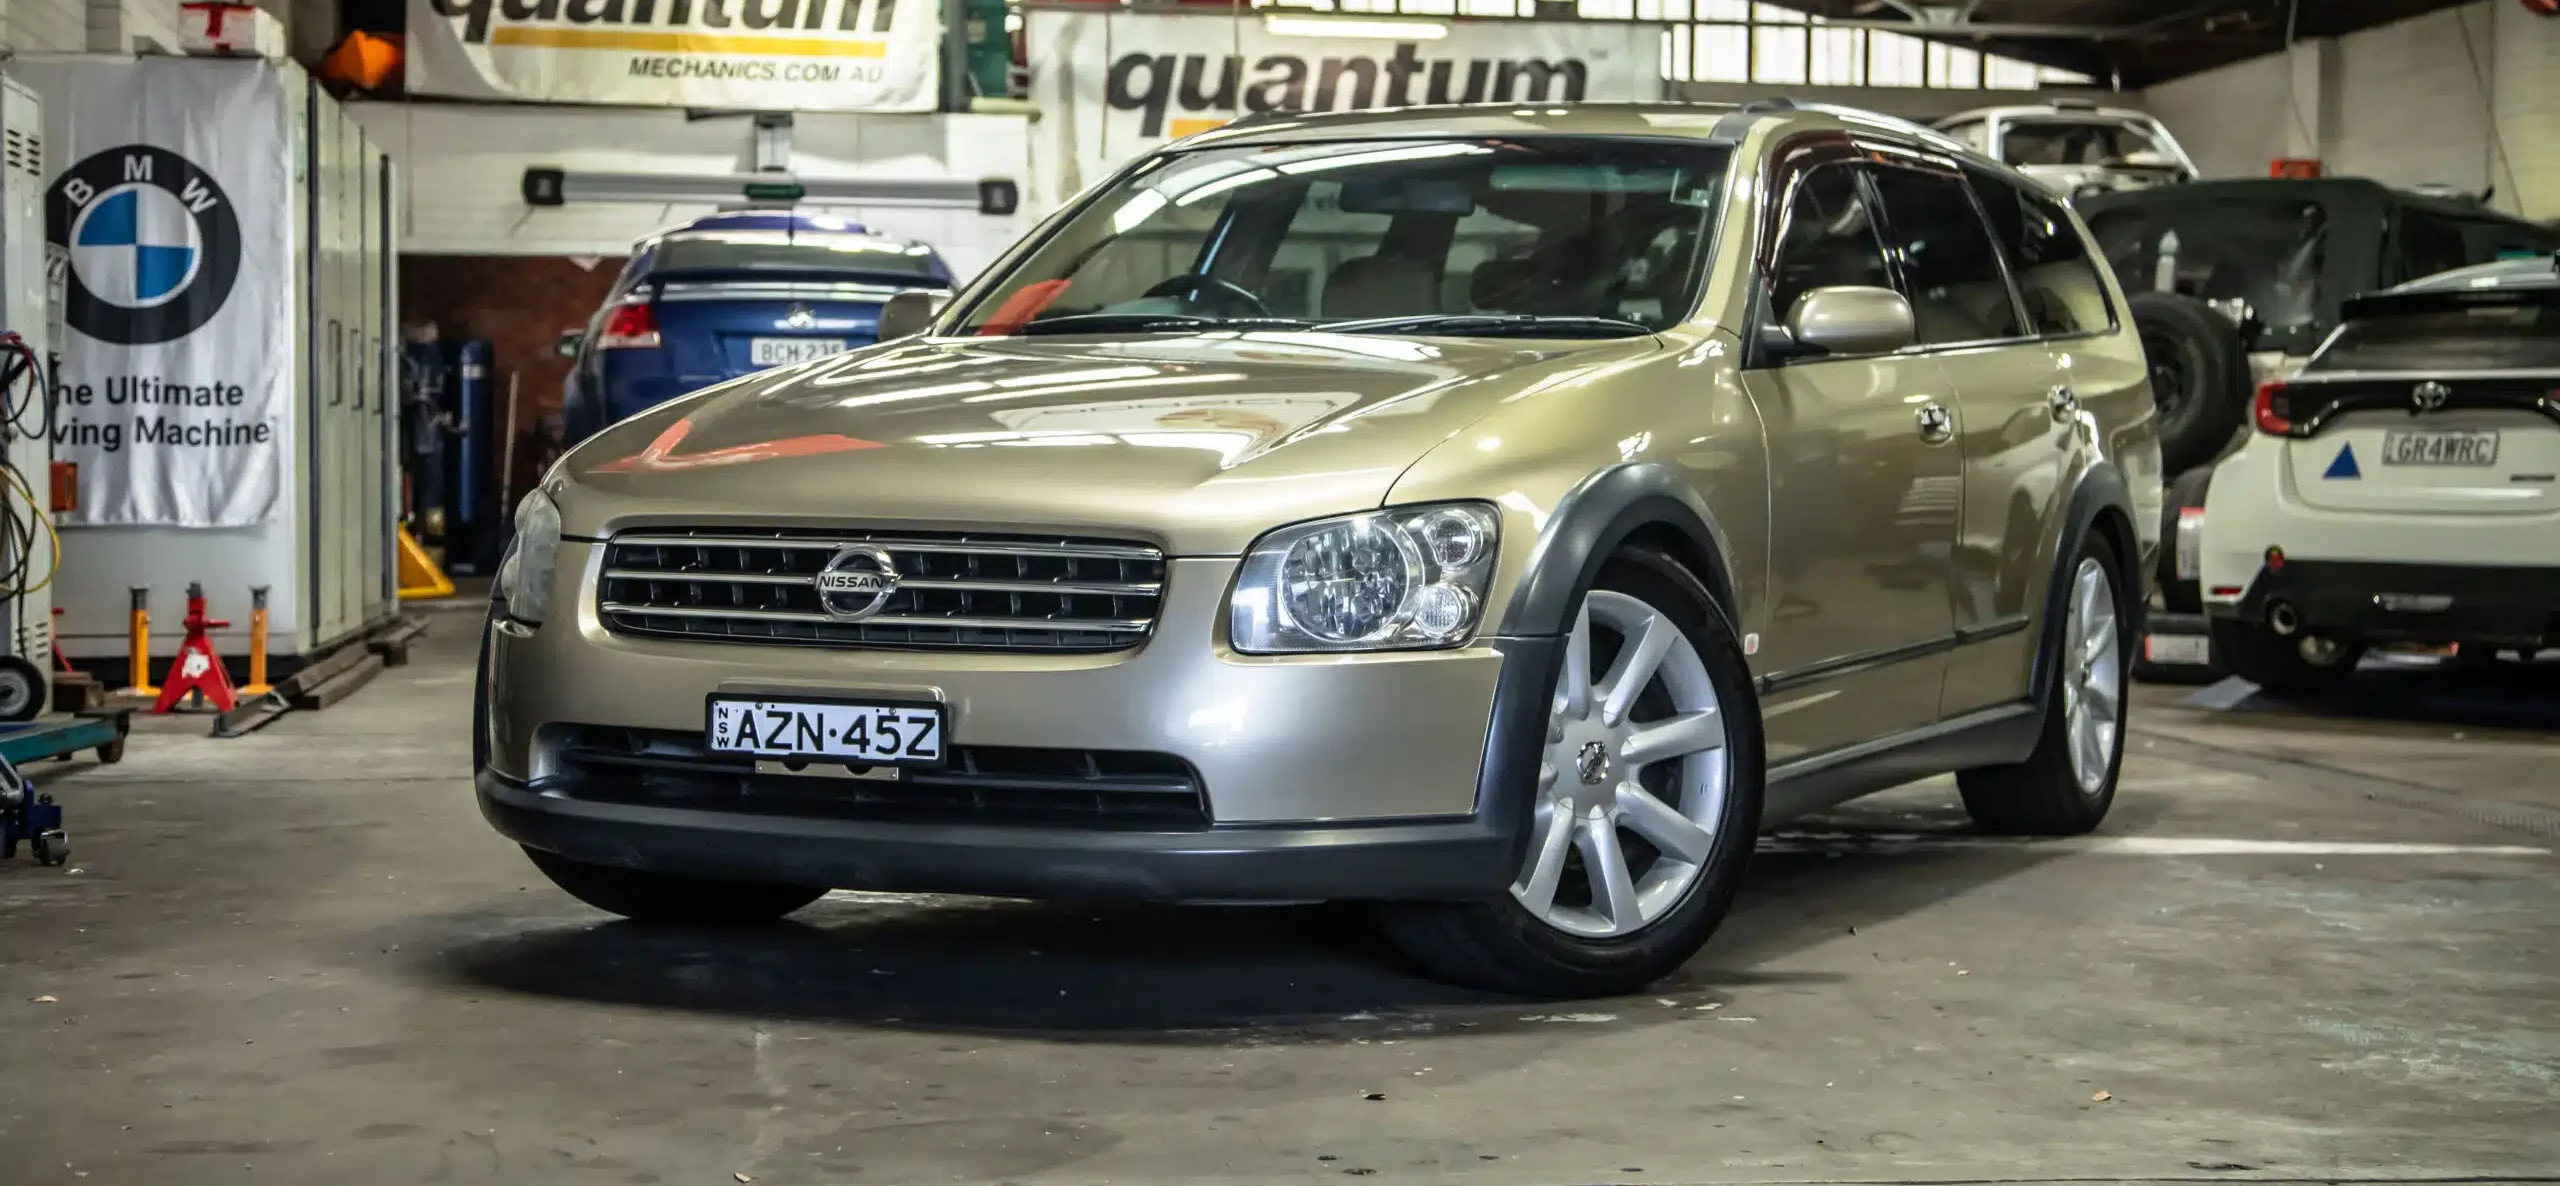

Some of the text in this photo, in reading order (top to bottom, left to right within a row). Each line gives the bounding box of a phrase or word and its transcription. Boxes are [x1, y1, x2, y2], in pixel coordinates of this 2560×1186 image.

[1107, 43, 1587, 137] quantum
[62, 154, 217, 215] BMW
[54, 376, 243, 407] he Ultimate
[53, 416, 270, 452] ving Machine
[2398, 435, 2491, 463] GR4WRC
[820, 575, 884, 588] NISSAN
[716, 707, 730, 748] NSW
